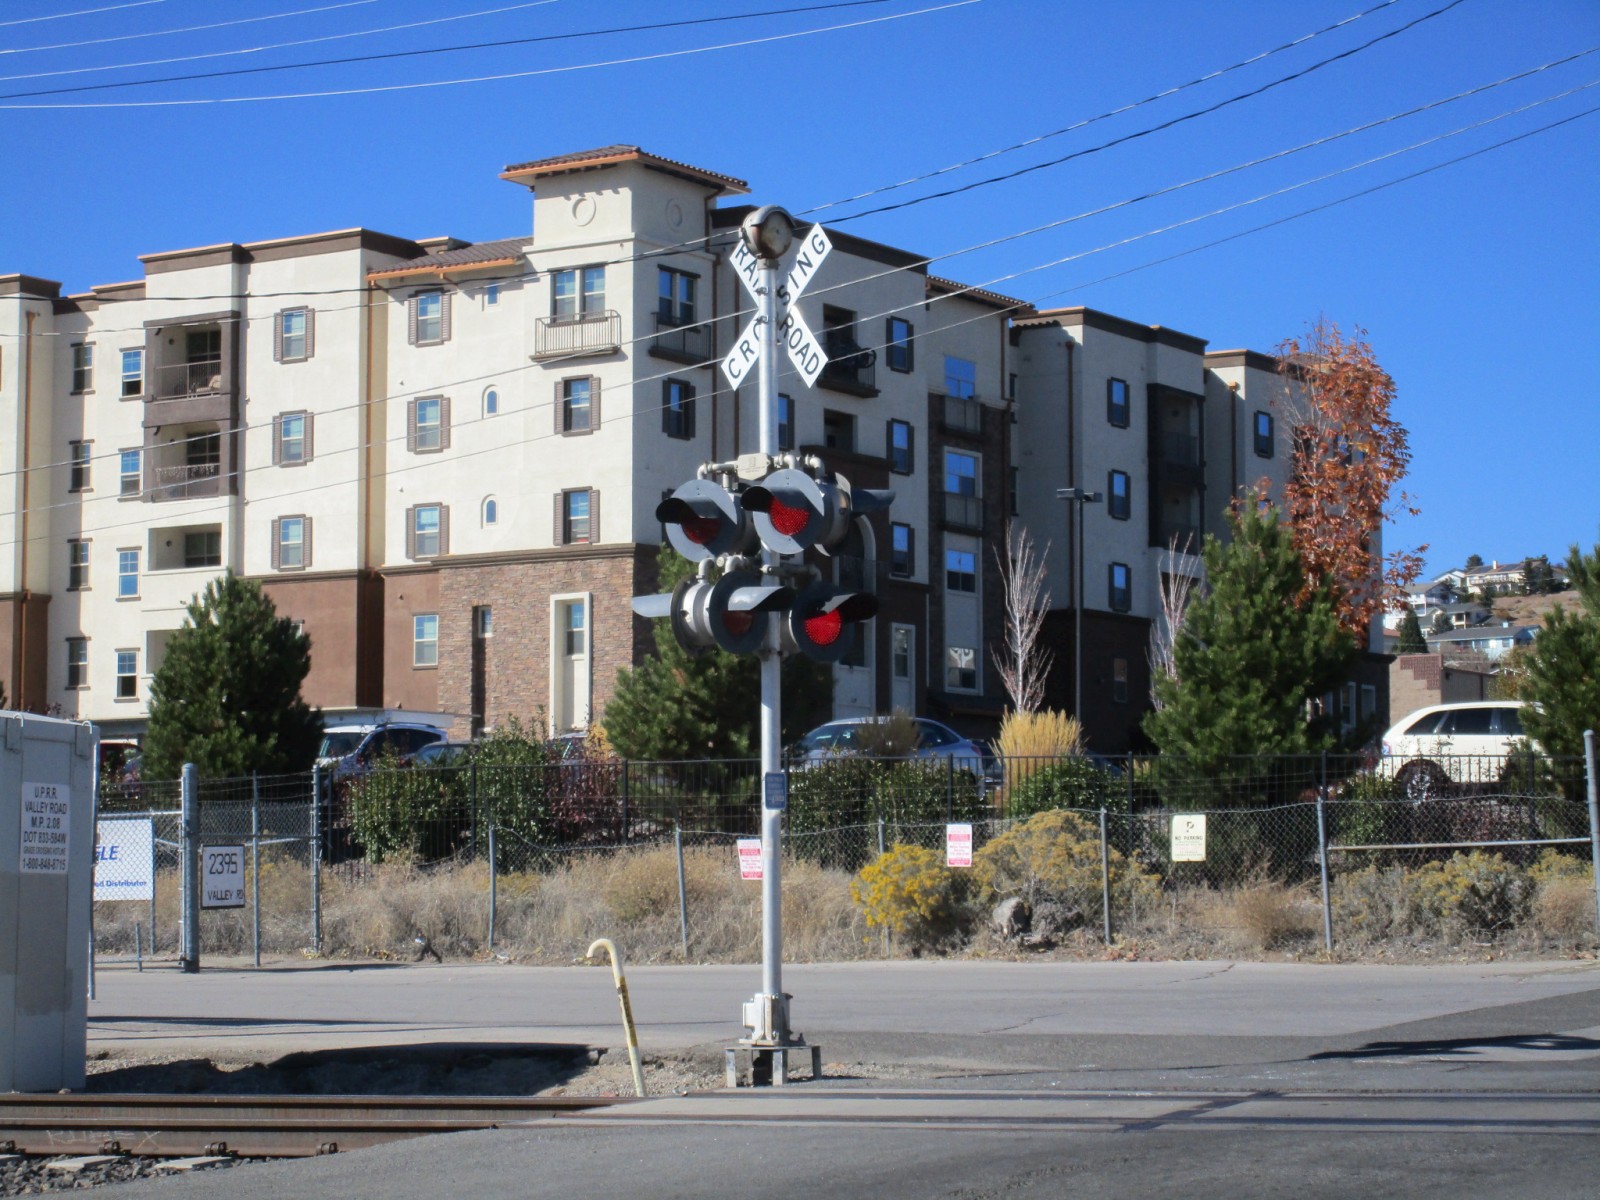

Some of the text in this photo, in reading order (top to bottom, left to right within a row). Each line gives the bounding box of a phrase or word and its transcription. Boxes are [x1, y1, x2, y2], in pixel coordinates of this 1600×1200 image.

[779, 311, 819, 375] ROAD
[25, 801, 67, 815] VALLEY ROAD
[46, 817, 61, 829] 2.08
[23, 831, 37, 843] DOT
[209, 853, 238, 875] 2395
[207, 889, 244, 901] VALLEY RD
